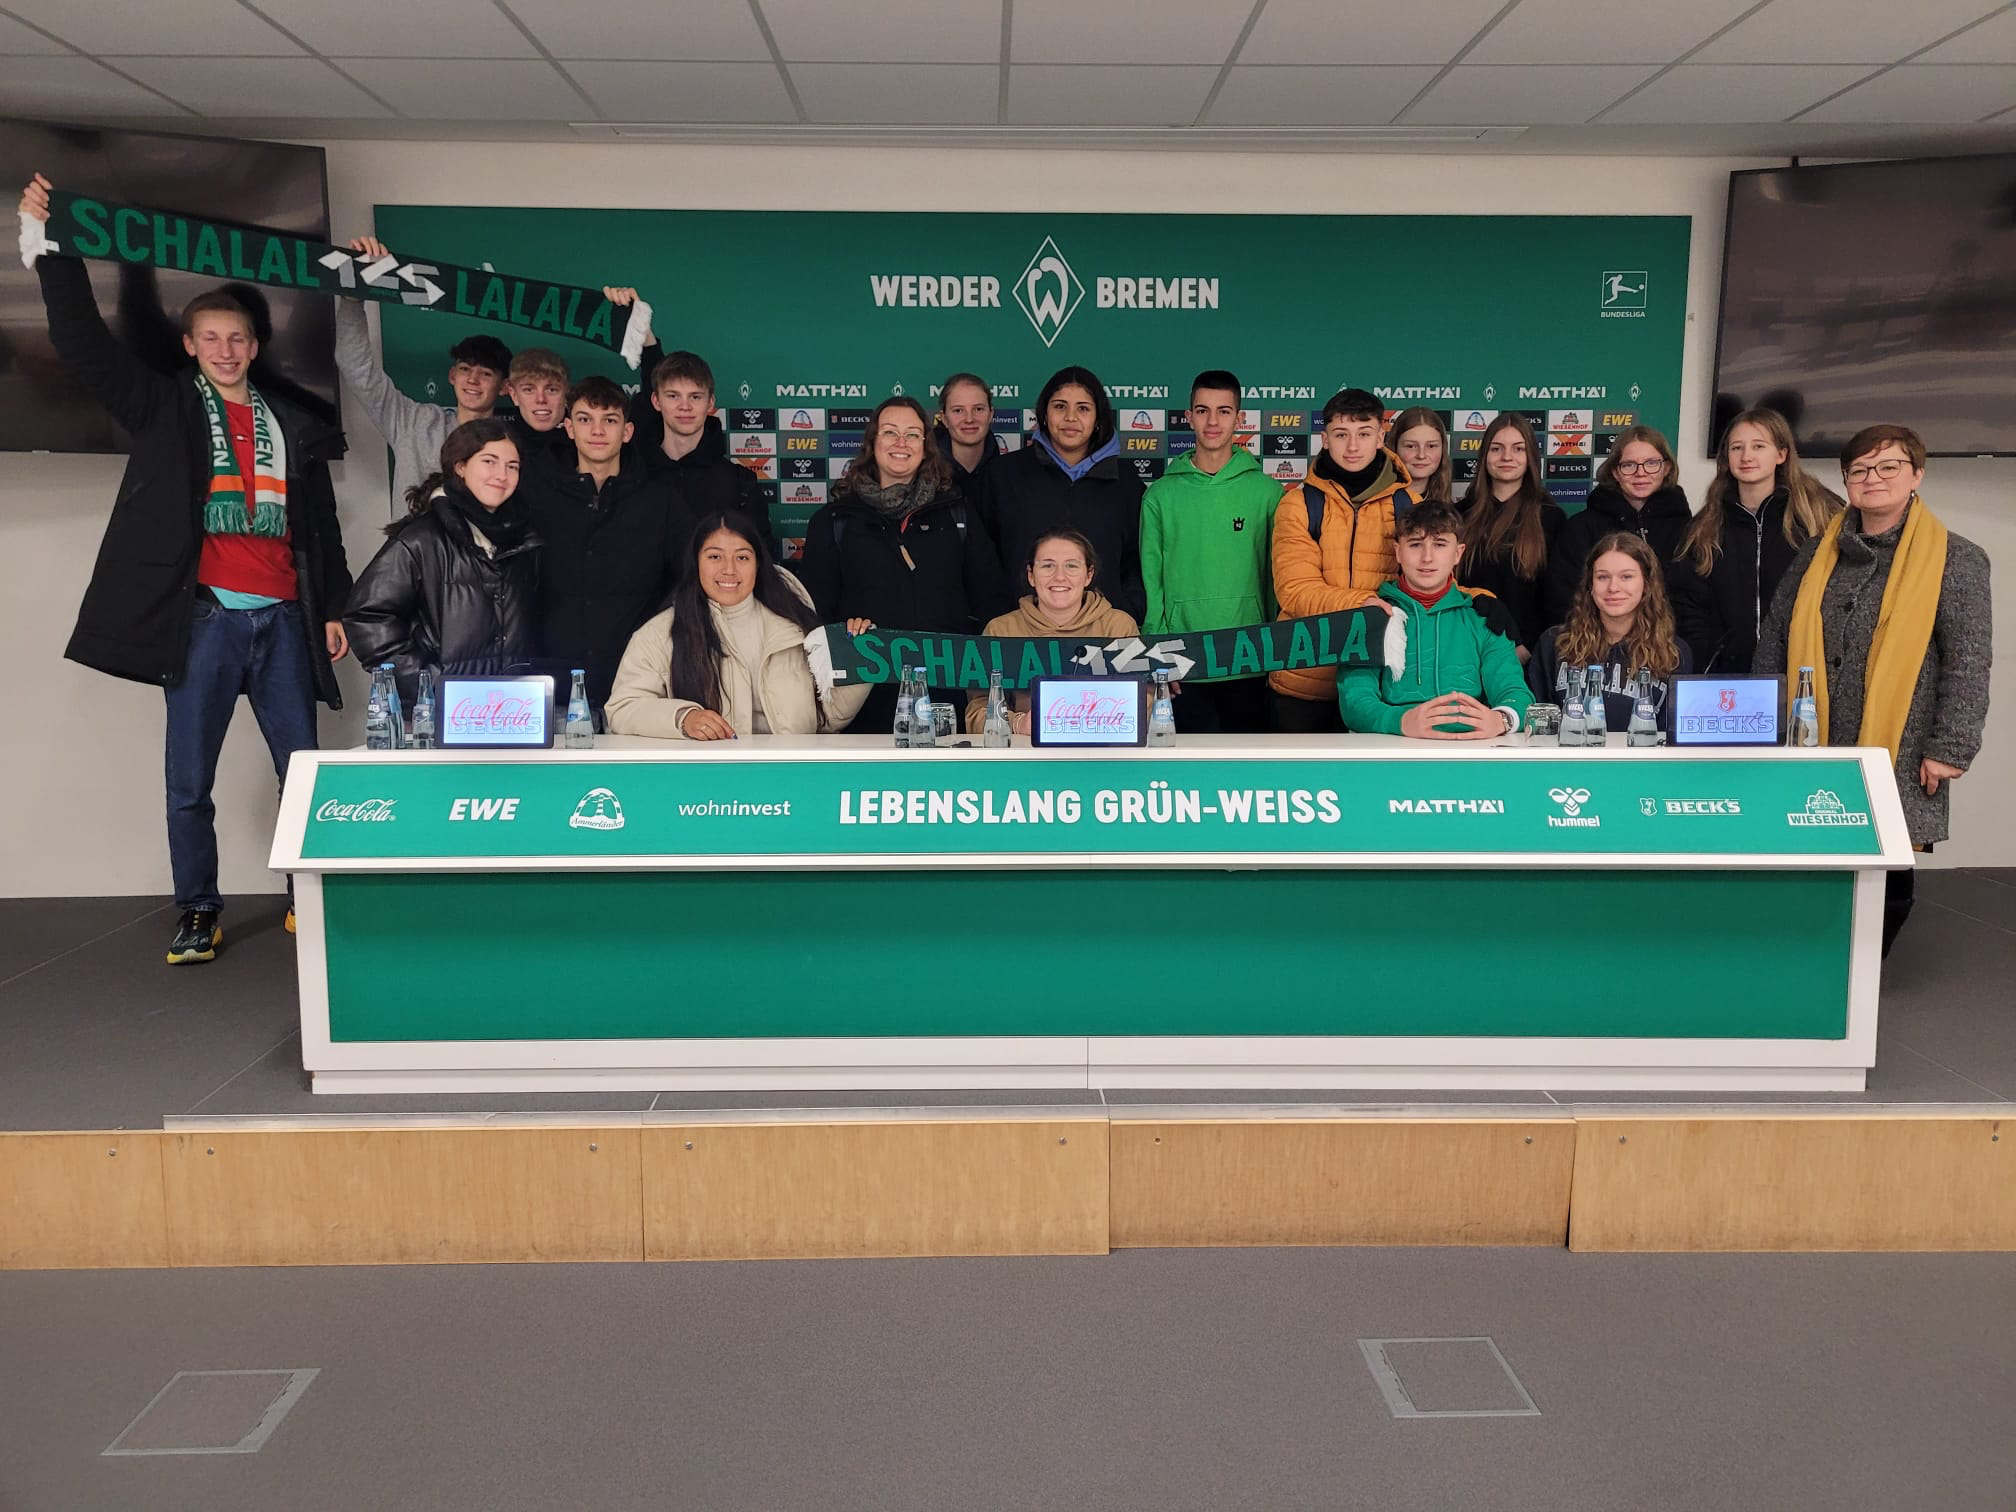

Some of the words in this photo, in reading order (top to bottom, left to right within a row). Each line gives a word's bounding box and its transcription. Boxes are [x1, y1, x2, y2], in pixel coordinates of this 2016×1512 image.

[69, 199, 321, 287] SCHALAL
[318, 250, 446, 306] 125
[456, 270, 613, 346] LALALA
[870, 275, 1001, 307] WERDER
[1096, 277, 1219, 309] BREMEN
[776, 384, 867, 397] MATTHÄI
[1103, 385, 1169, 398] ATTHÄI
[1373, 386, 1461, 399] MATTHÄI
[1519, 386, 1606, 399] MATTHÄI
[992, 416, 1018, 424] ninvest
[1270, 415, 1302, 427] EWE
[1603, 414, 1633, 426] EWE
[786, 438, 818, 450] EWE
[831, 440, 863, 448] wohninv
[1127, 438, 1158, 450] EWE
[1170, 441, 1196, 449] wohnin
[1460, 439, 1482, 451] EW
[1204, 612, 1369, 678] LALALA
[1680, 712, 1775, 734] BECK'S
[678, 799, 791, 817] wohninvest
[838, 790, 1081, 825] LEBENSLANG
[1094, 780, 1342, 824] GRÜN-WEISS
[1389, 799, 1505, 814] MATTHÄI
[1665, 799, 1741, 814] BECK'S
[316, 798, 398, 822] Coca-Cola
[448, 798, 520, 821] EWE
[1548, 815, 1600, 828] hummel
[1790, 815, 1865, 824] WIESENHOF
